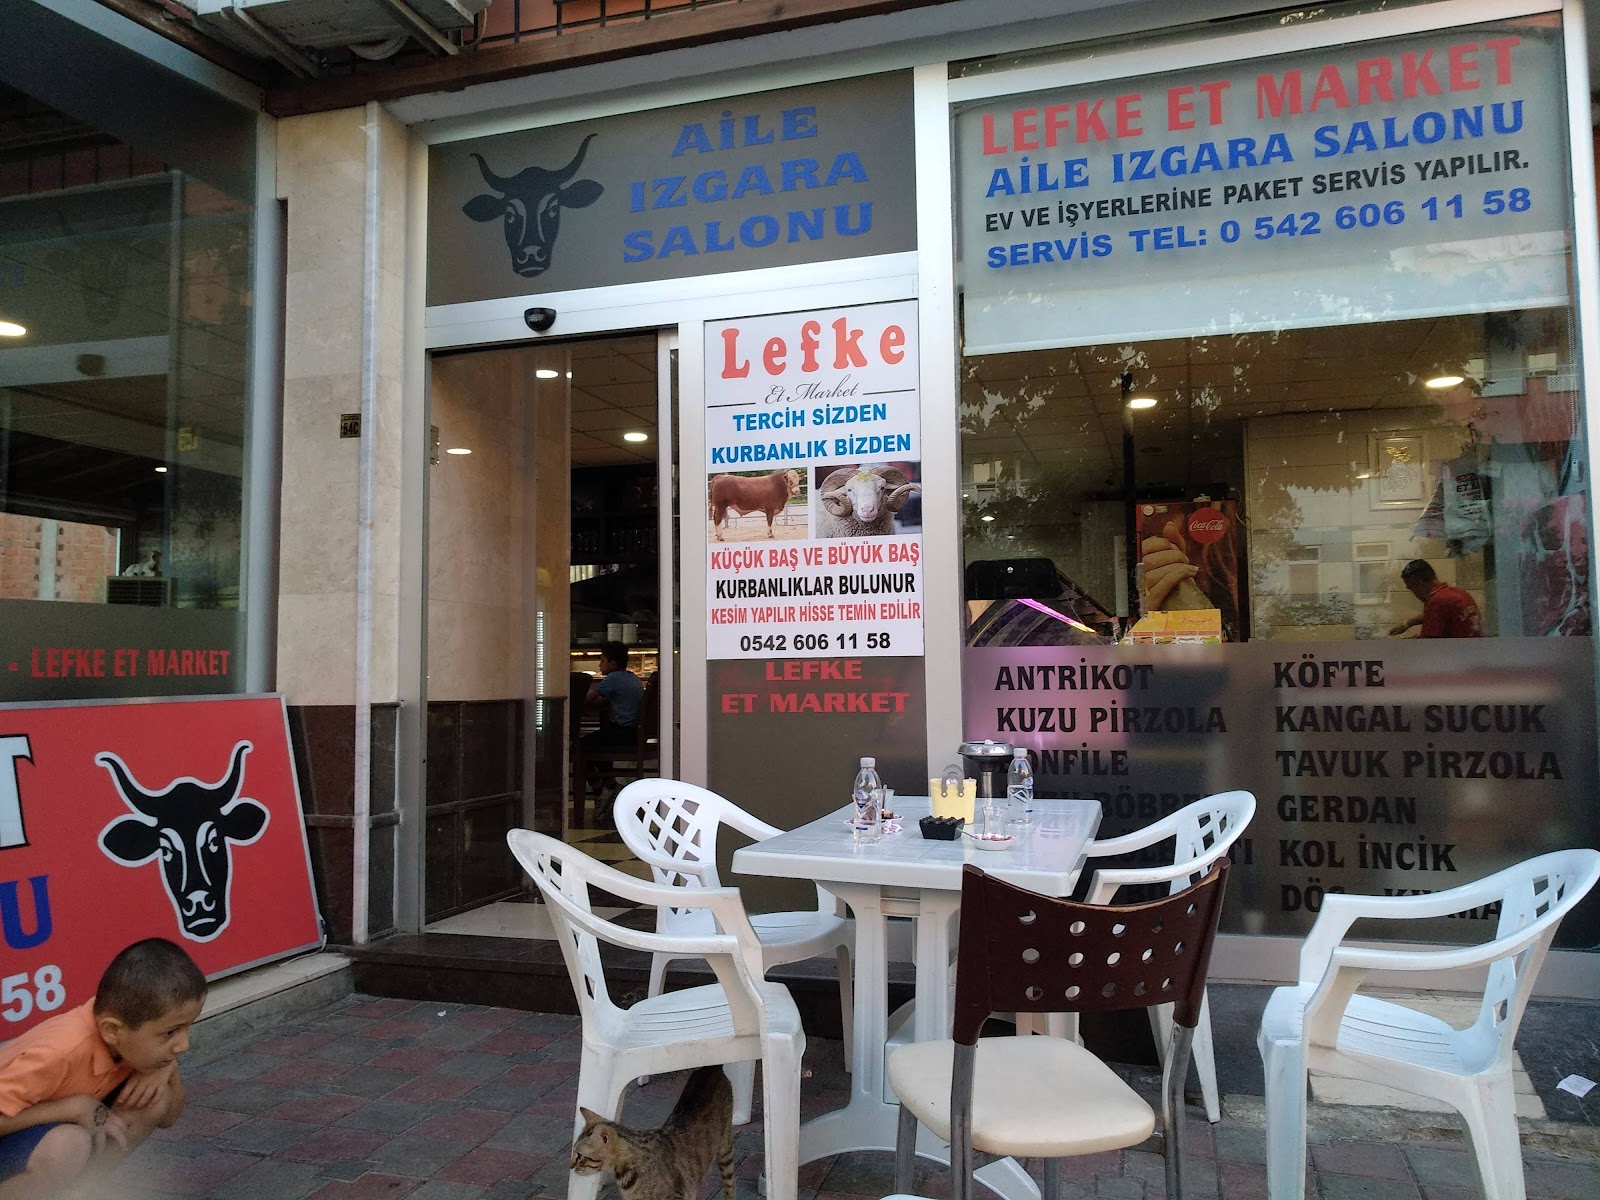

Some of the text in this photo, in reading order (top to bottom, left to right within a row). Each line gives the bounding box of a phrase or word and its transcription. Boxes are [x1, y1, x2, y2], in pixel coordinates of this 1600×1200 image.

[982, 37, 1523, 156] LEFKE ET MARKET
[671, 106, 818, 158] AİLE
[985, 100, 1526, 199] AİLE IZGARA SALONU
[629, 151, 869, 214] IZGARA
[985, 149, 1530, 233] EV VE İŞYERLERİNE PAKET SERVİS YAPILIR.
[623, 201, 874, 264] SALONU
[987, 186, 1533, 270] SERVİS TEL: 0 542 606 11 58
[720, 317, 906, 380] Lefke
[764, 374, 860, 405] Et Market
[732, 403, 887, 432] TERCİH SİZDEN
[711, 434, 912, 465] KURBANLIK BİZDEN
[711, 542, 920, 574] KÜÇÜK BAŞ VE BÜYÜK BAŞ
[716, 573, 916, 599] KURBANLIKLAR BULUNUR
[711, 598, 921, 625] KESİM YAPILIR HİSSE TEMİN EDİLİR
[740, 632, 891, 651] 0542 606 11 58
[31, 647, 230, 678] LEFKE ET MARKET
[765, 659, 862, 681] LEFKE
[994, 658, 1154, 691] ANTRİKOT
[1273, 653, 1385, 688] KÖFTE
[721, 692, 910, 713] ET MARKET
[996, 699, 1228, 733] KUZU PİRZOLA
[1275, 704, 1547, 733] KANGAL SUCUK
[999, 742, 1129, 776] ONFİLE
[1275, 743, 1563, 780] TAVUK PİRZOLA
[1277, 795, 1416, 825] GERDAN
[1279, 839, 1345, 869] KOL
[1358, 833, 1458, 872] İNCİK
[2, 964, 66, 1022] 58
